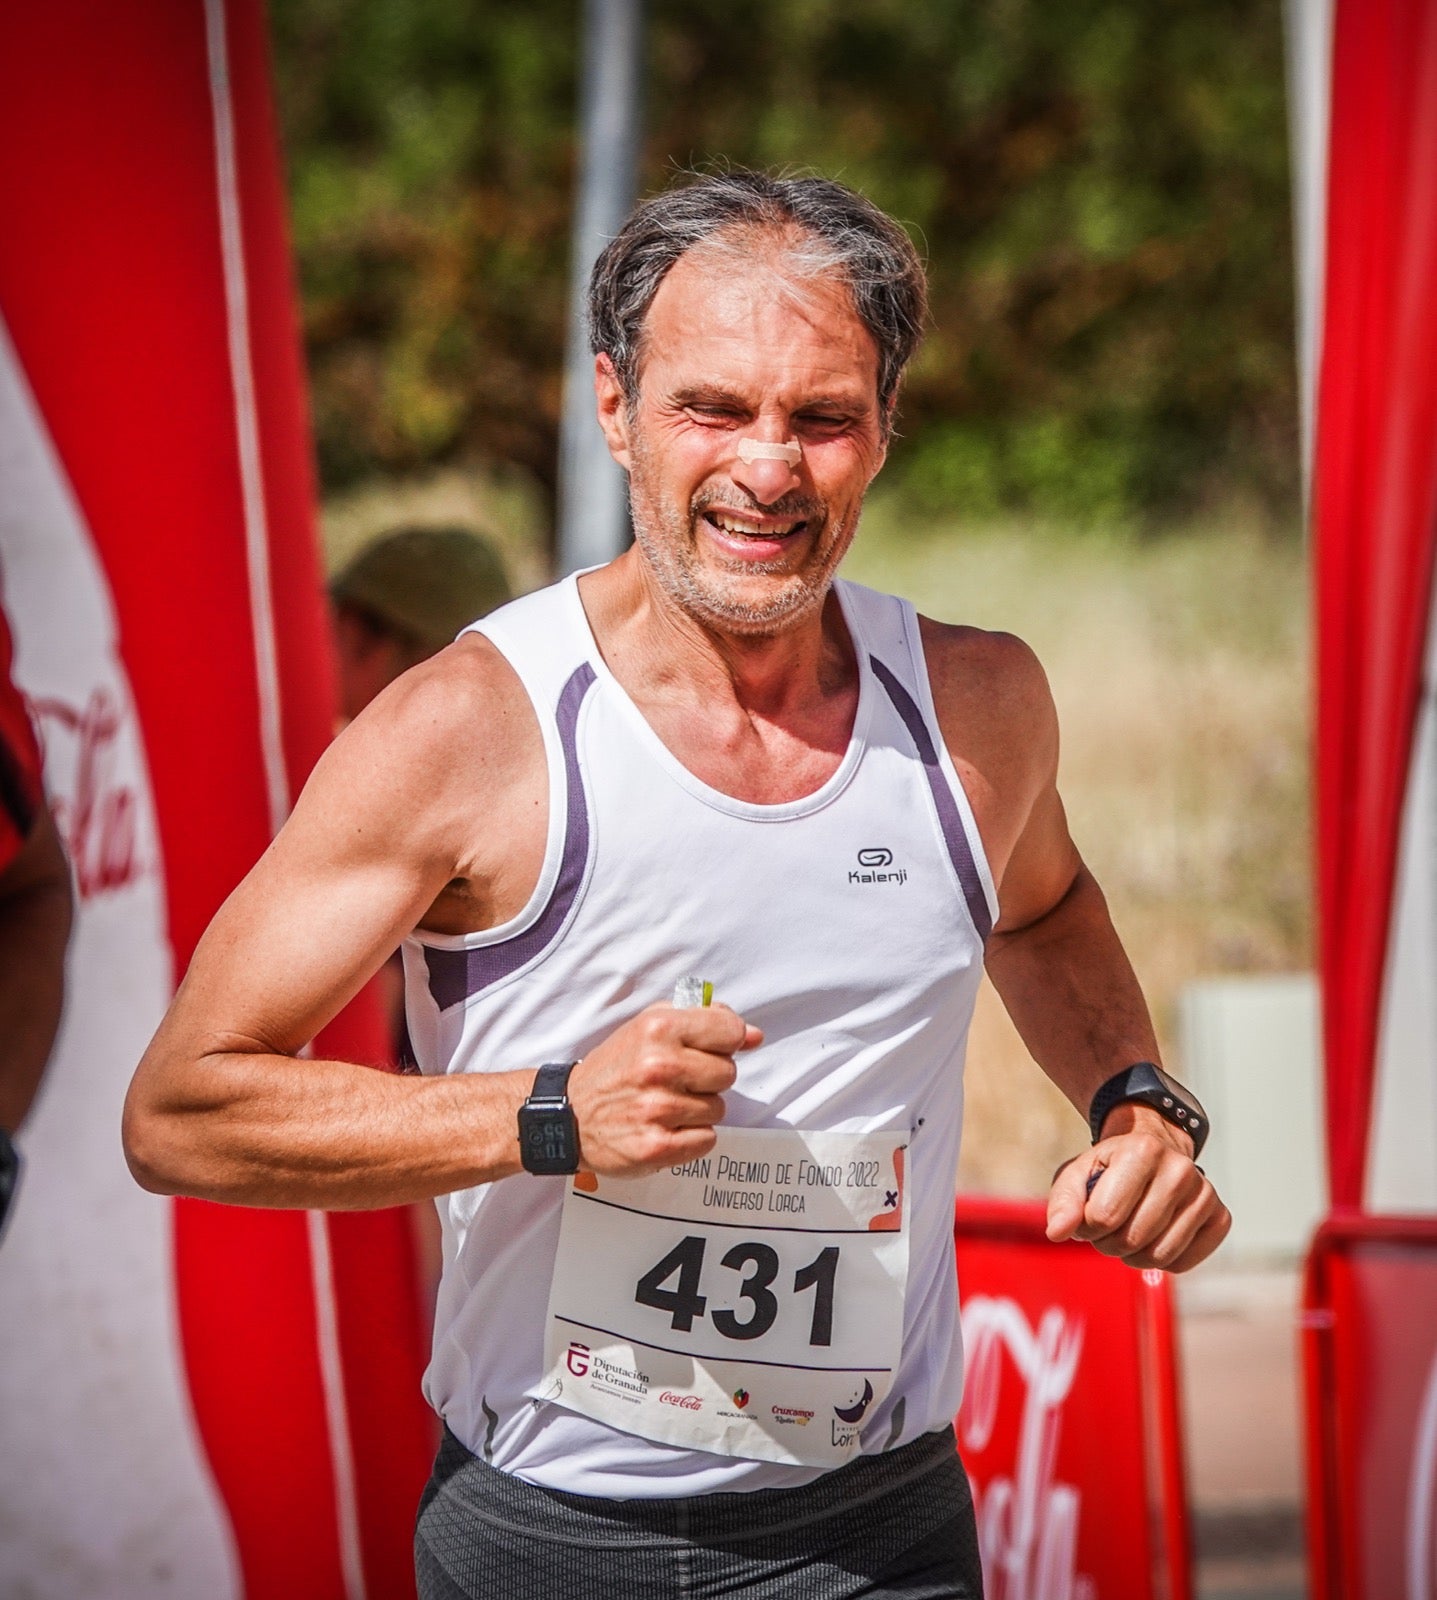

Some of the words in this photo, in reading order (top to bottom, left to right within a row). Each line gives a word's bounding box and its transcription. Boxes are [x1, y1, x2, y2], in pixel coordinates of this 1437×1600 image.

[848, 869, 908, 886] Kalenji
[671, 1158, 712, 1180] GRAN
[717, 1155, 770, 1184] PREMIO
[775, 1163, 793, 1185] DE
[797, 1160, 842, 1187] FONDO
[846, 1161, 880, 1188] 2022
[702, 1185, 764, 1212] UNIVERSO
[768, 1190, 806, 1214] LORCA
[635, 1235, 840, 1347] 431
[592, 1369, 604, 1381] de
[605, 1373, 648, 1394] Granada
[594, 1357, 650, 1383] Diputación
[772, 1405, 815, 1418] Cruzcampo
